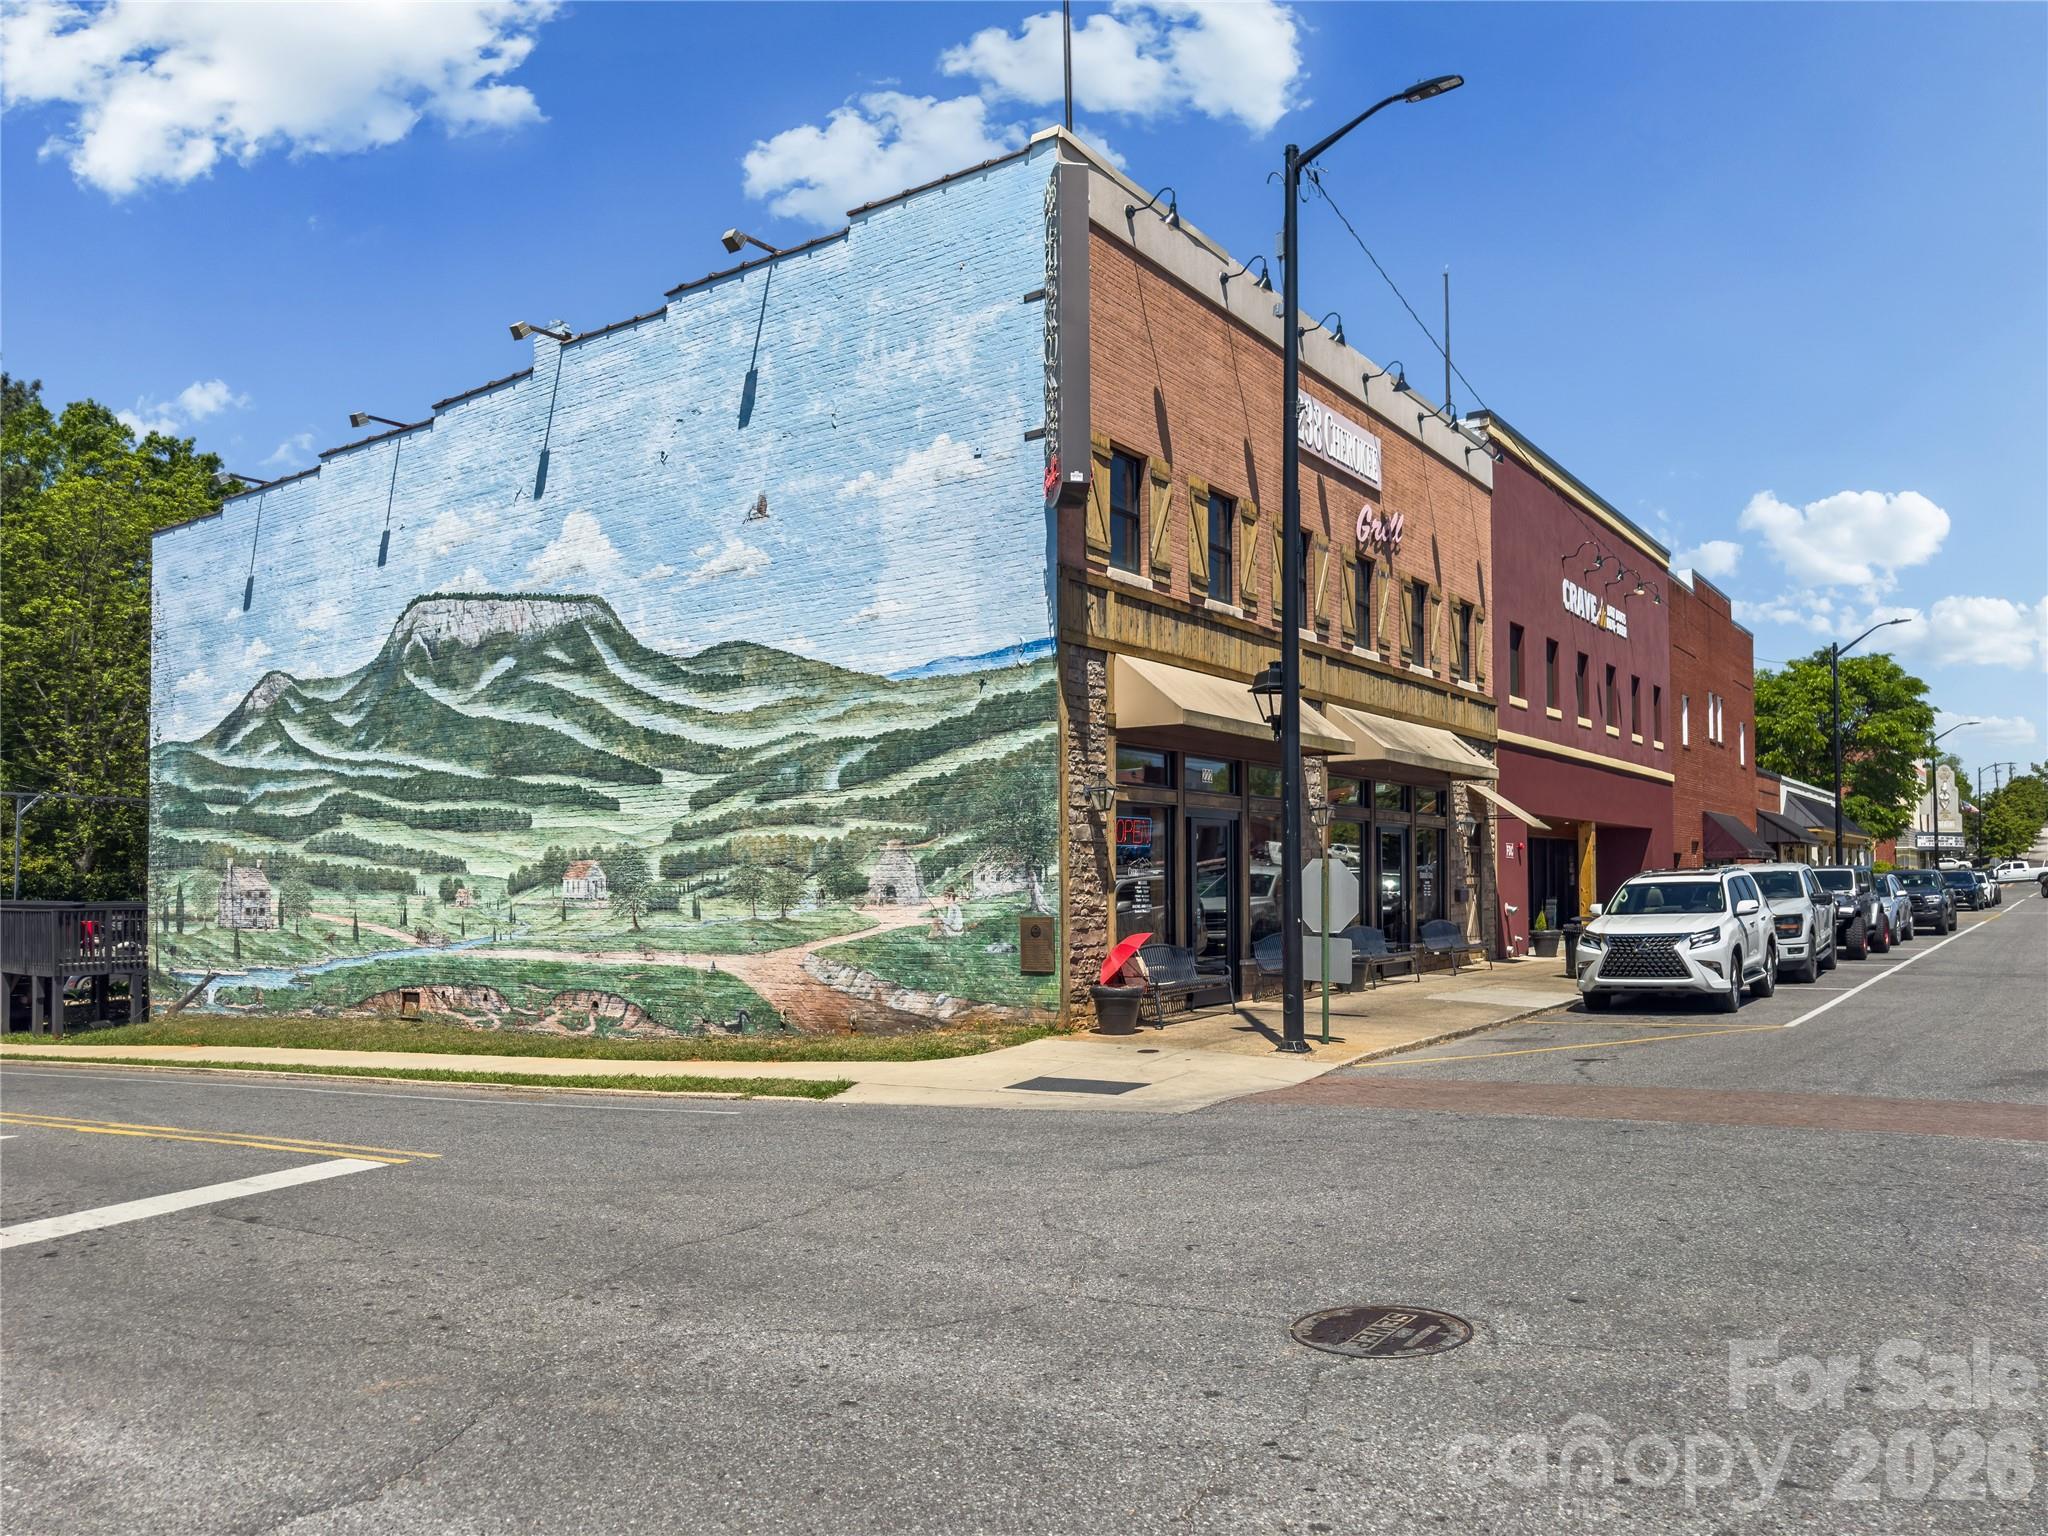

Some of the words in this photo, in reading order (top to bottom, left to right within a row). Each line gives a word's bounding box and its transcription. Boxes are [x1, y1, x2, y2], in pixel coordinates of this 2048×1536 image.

[1298, 397, 1322, 451] 238
[1324, 412, 1378, 483] CHEROKEE
[1356, 504, 1404, 542] Grill
[1562, 578, 1598, 625] CRAVE
[1115, 819, 1149, 844] OPEN
